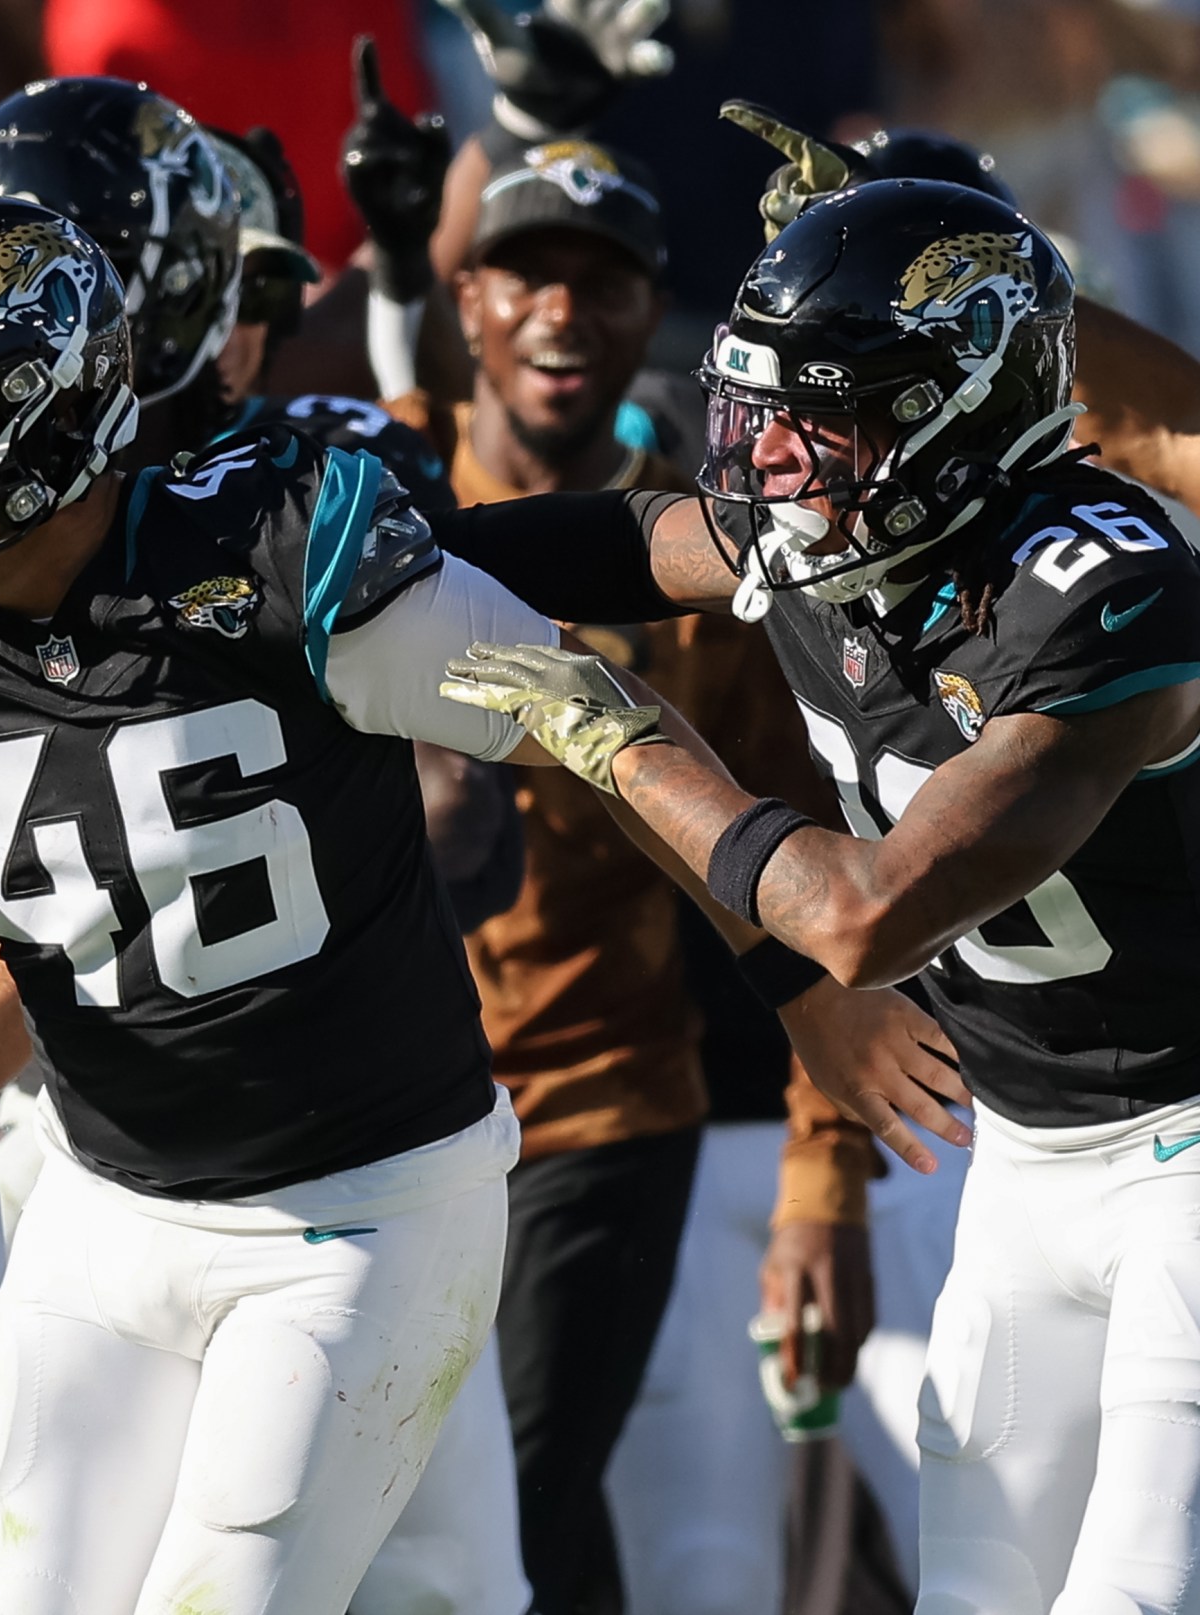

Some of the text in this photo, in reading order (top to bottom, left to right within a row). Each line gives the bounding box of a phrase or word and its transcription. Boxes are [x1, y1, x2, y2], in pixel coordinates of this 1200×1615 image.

[726, 347, 752, 374] JAX
[799, 375, 851, 389] OAKLEY
[1011, 501, 1169, 598] 26
[45, 654, 77, 678] NFL
[845, 658, 864, 682] NFL
